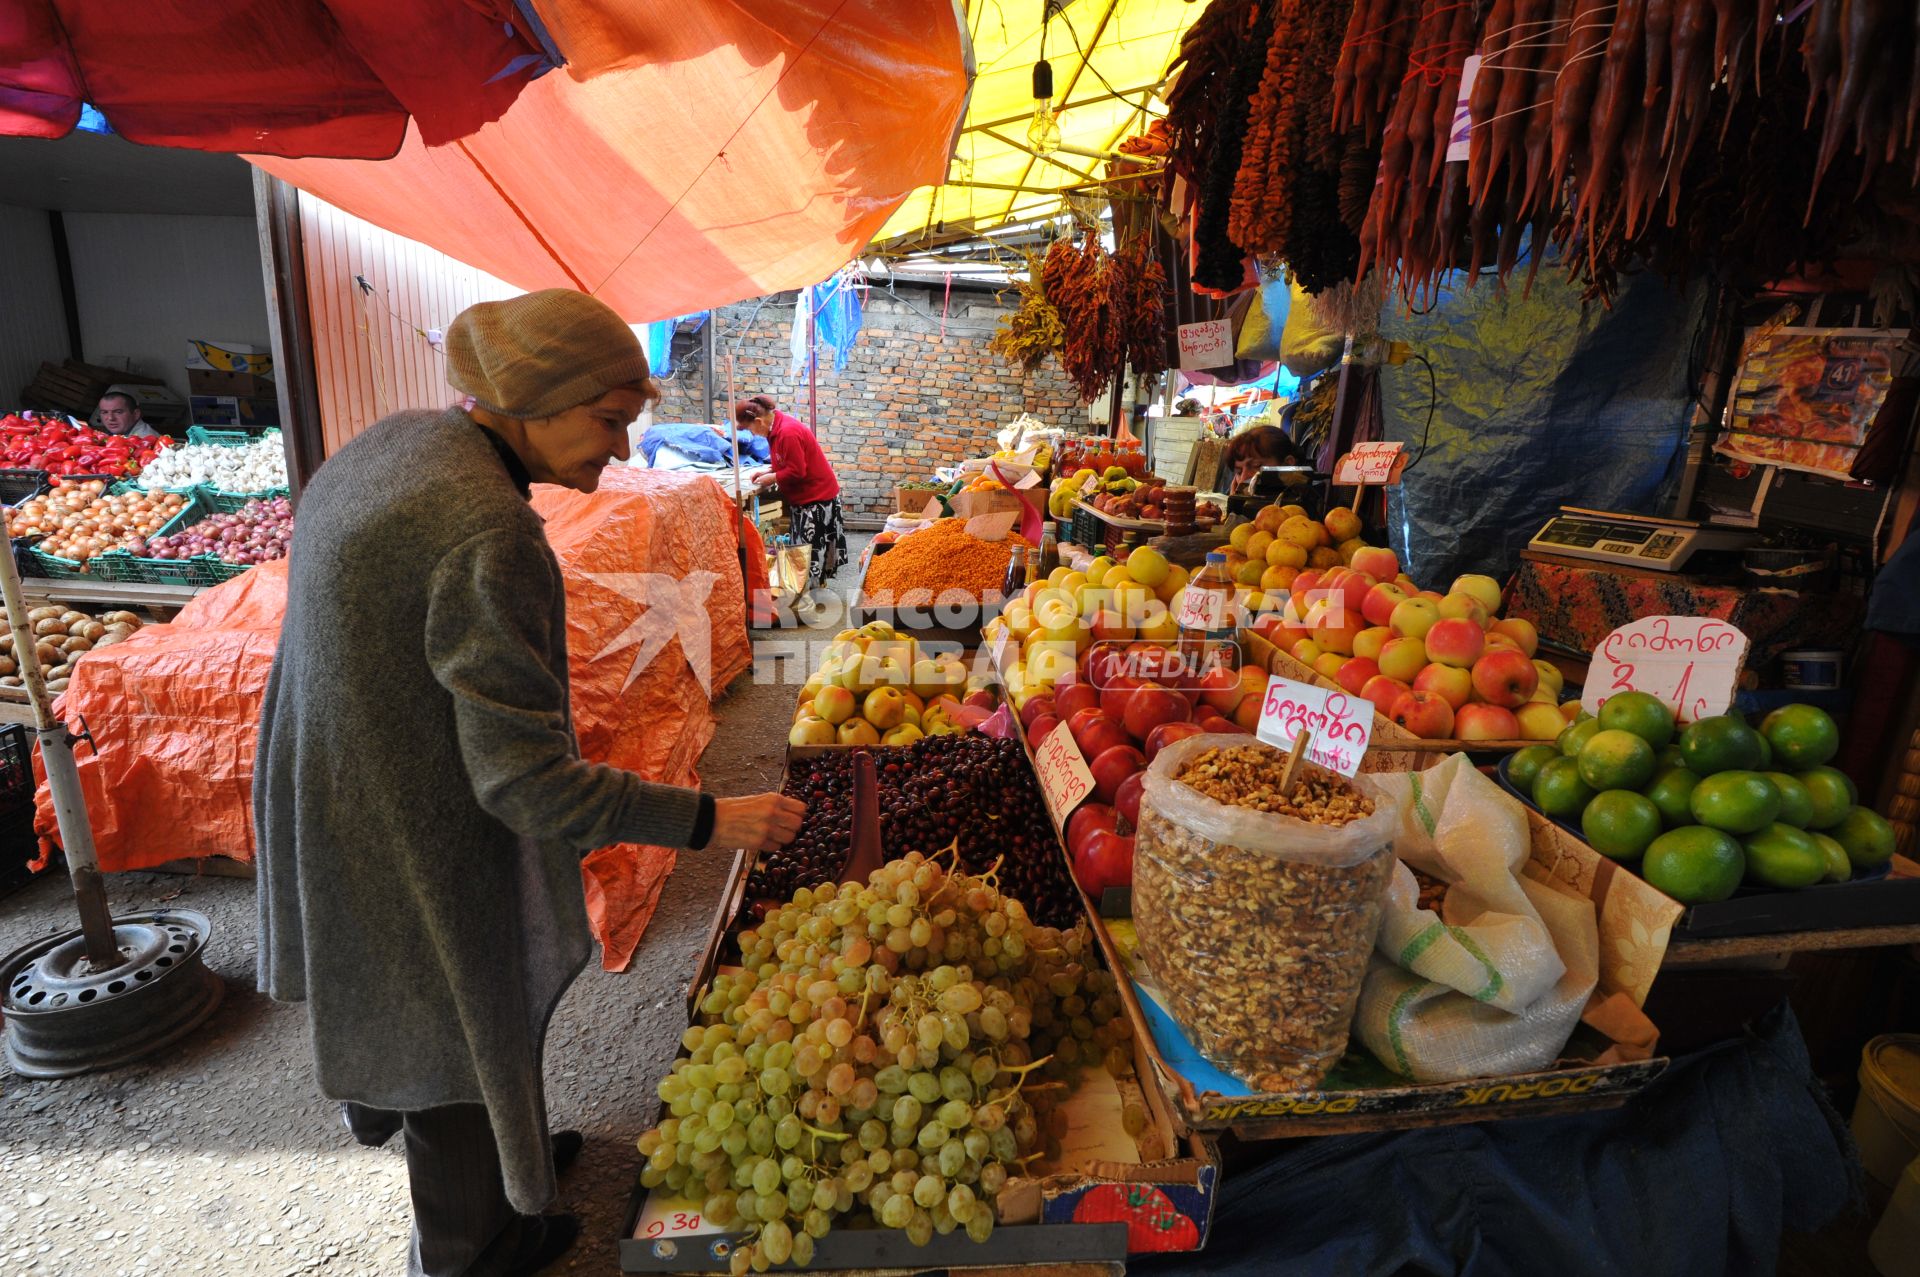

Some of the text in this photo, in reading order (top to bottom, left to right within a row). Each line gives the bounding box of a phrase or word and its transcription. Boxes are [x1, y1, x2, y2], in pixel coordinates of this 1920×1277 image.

[1831, 365, 1852, 382] 41
[1604, 618, 1735, 664] ლიმონი
[1265, 683, 1366, 747] ნიგოზი
[1456, 1075, 1602, 1105] DORUK
